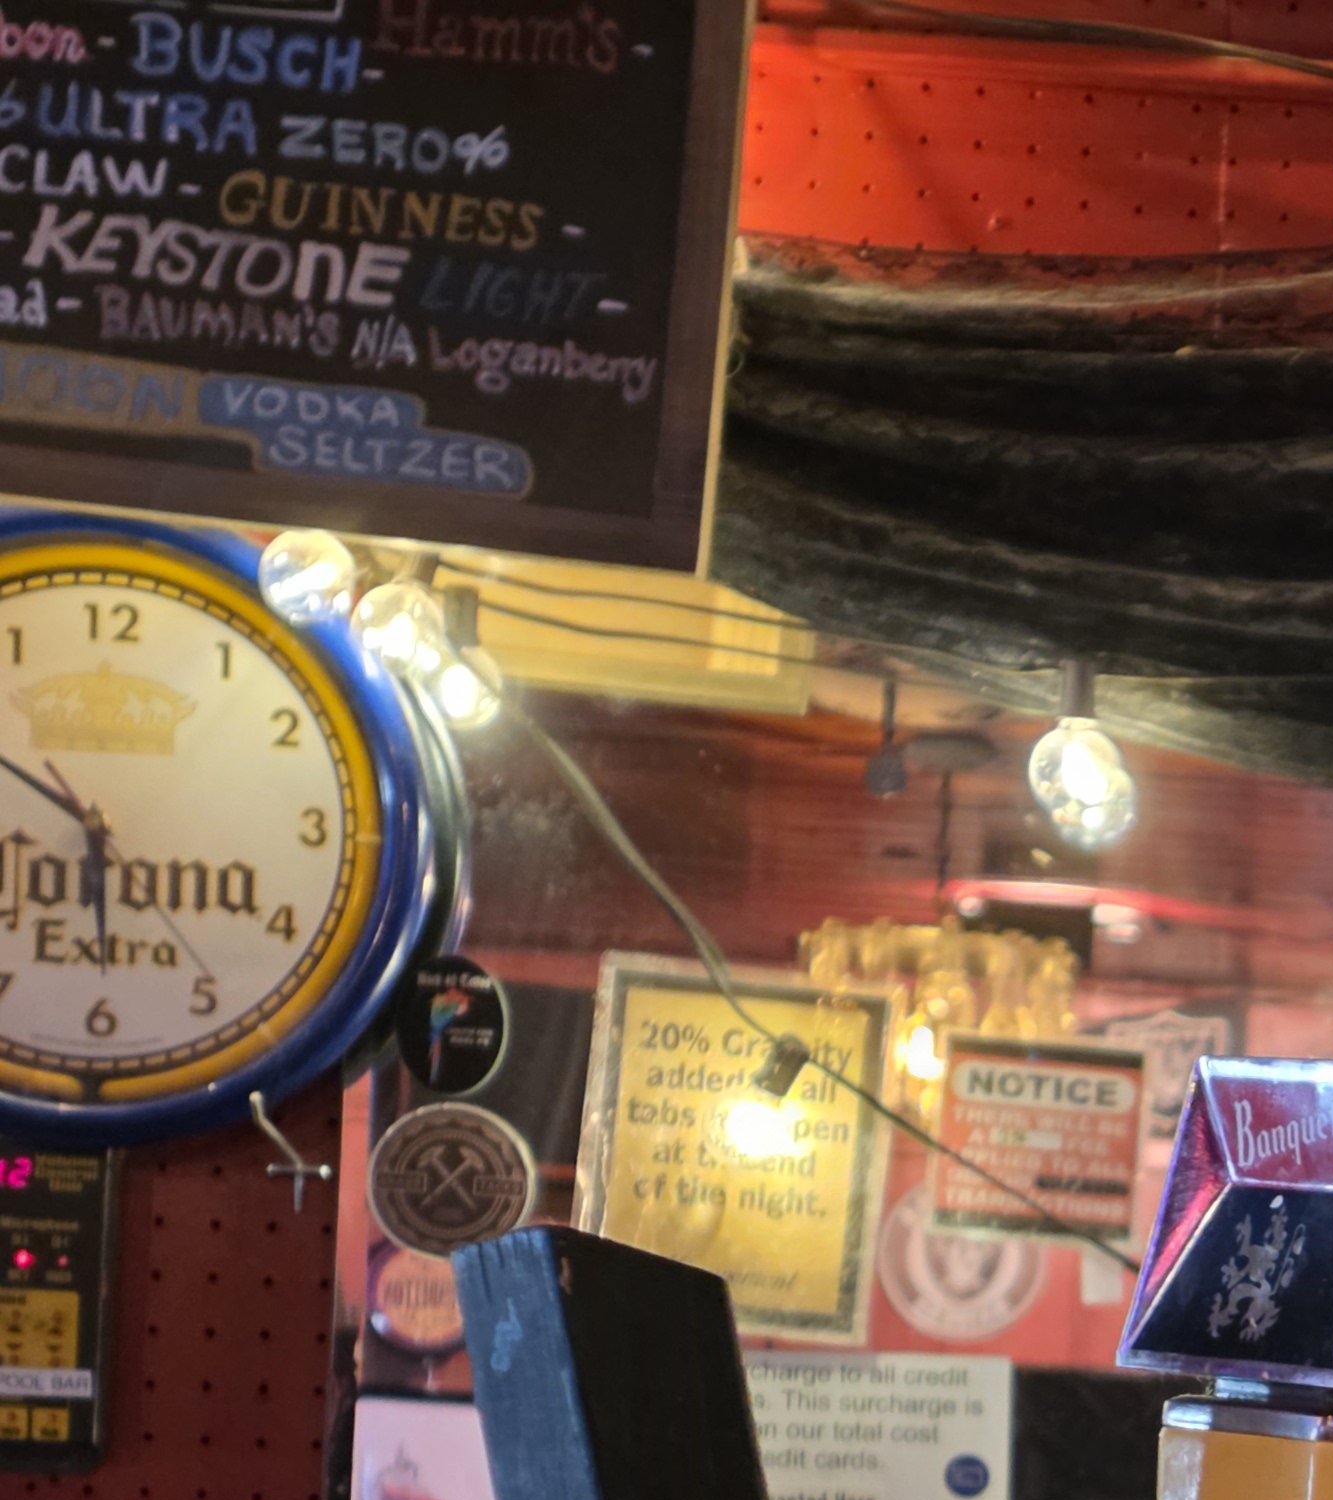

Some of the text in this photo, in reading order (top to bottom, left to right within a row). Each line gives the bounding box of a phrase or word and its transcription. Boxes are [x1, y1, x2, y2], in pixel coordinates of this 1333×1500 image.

[38, 80, 512, 176] ULTRA ZERO%
[219, 170, 546, 250] GUINNESS
[97, 285, 658, 402] BAUMAN'S N/A Loganberry
[0, 345, 402, 428] OON VODKA
[267, 424, 516, 488] SELTZER
[83, 604, 139, 645] 12
[216, 640, 233, 680] 1
[270, 708, 301, 748] 2
[299, 807, 329, 849] 3
[33, 917, 178, 968] Extra
[265, 904, 297, 944] 4
[188, 974, 218, 1017] 5
[84, 998, 119, 1039] 6
[638, 1020, 853, 1079] 20% Graity
[801, 1076, 837, 1106] all
[967, 1067, 1120, 1108] NOTICE
[627, 1097, 850, 1144] tabs pen
[652, 1142, 685, 1167] at
[737, 1184, 827, 1221] night.
[839, 1366, 862, 1384] to
[869, 1366, 896, 1384] all
[903, 1367, 969, 1387] credit
[783, 1388, 831, 1411] This
[838, 1393, 958, 1419] surcharge
[963, 1398, 984, 1416] is
[785, 1422, 940, 1444] our total cost
